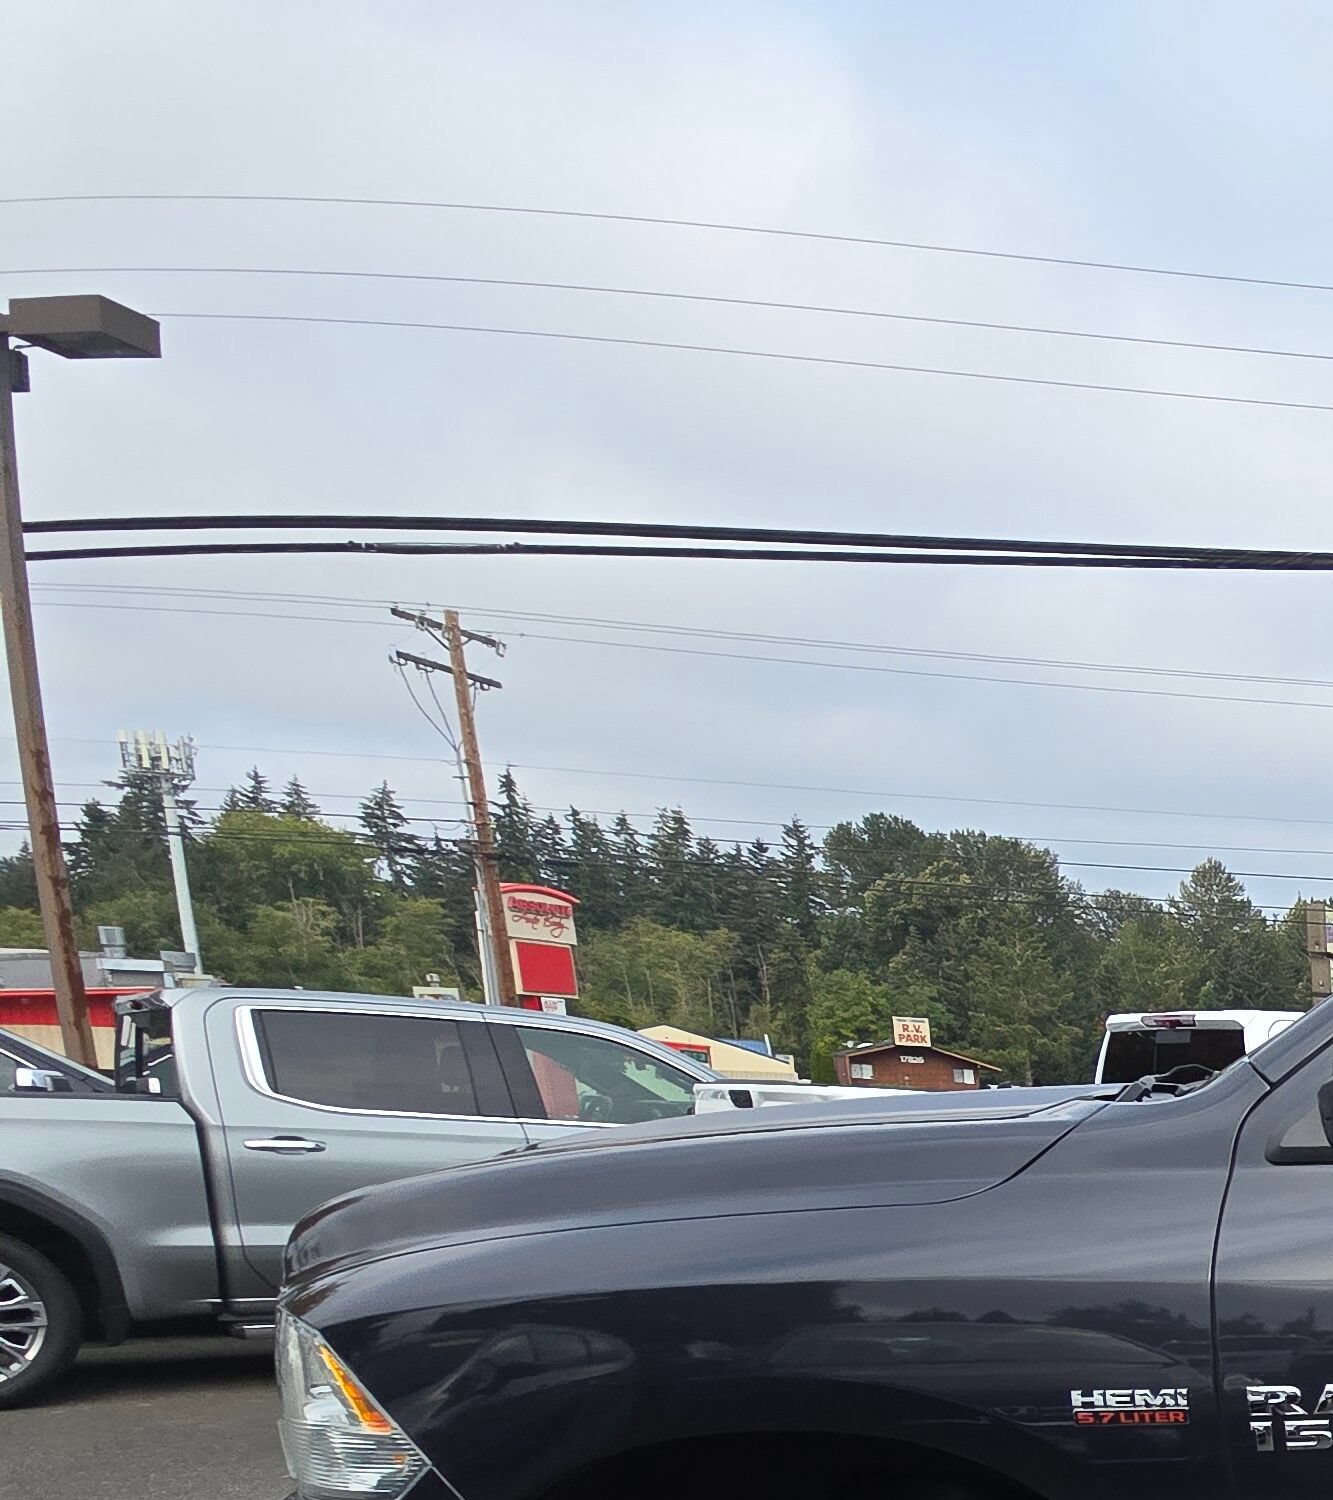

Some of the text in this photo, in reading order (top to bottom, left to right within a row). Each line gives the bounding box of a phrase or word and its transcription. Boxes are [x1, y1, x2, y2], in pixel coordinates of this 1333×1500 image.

[898, 1034, 927, 1043] PARK
[1071, 1388, 1188, 1406] HEMI
[1120, 1411, 1185, 1423] LITER
